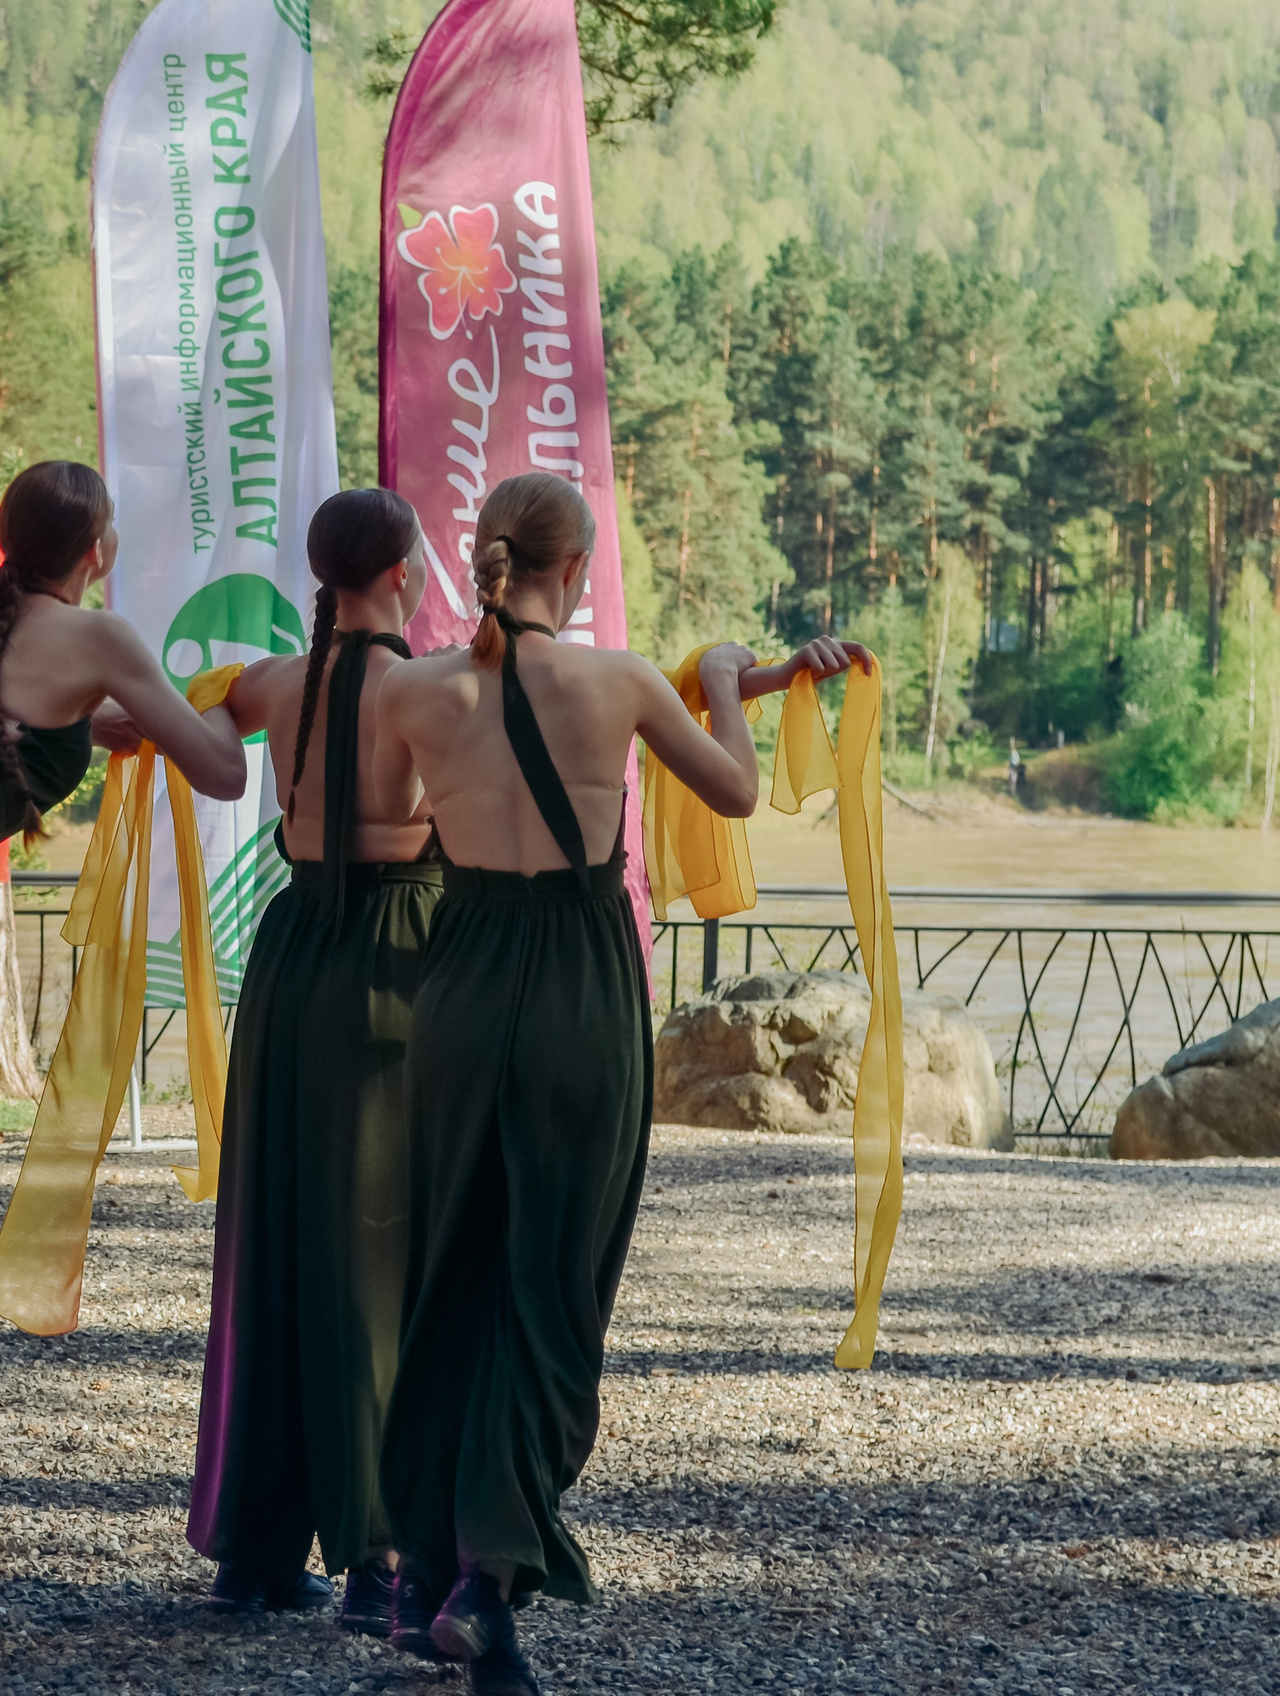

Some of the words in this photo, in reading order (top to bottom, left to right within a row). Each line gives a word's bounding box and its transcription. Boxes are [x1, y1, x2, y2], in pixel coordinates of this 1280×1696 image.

[163, 53, 187, 132] центр
[205, 52, 251, 184] КРАЯ
[163, 143, 201, 392] информационный
[214, 206, 278, 549] АЛТАЙСКОГО
[177, 402, 217, 555] туристский
